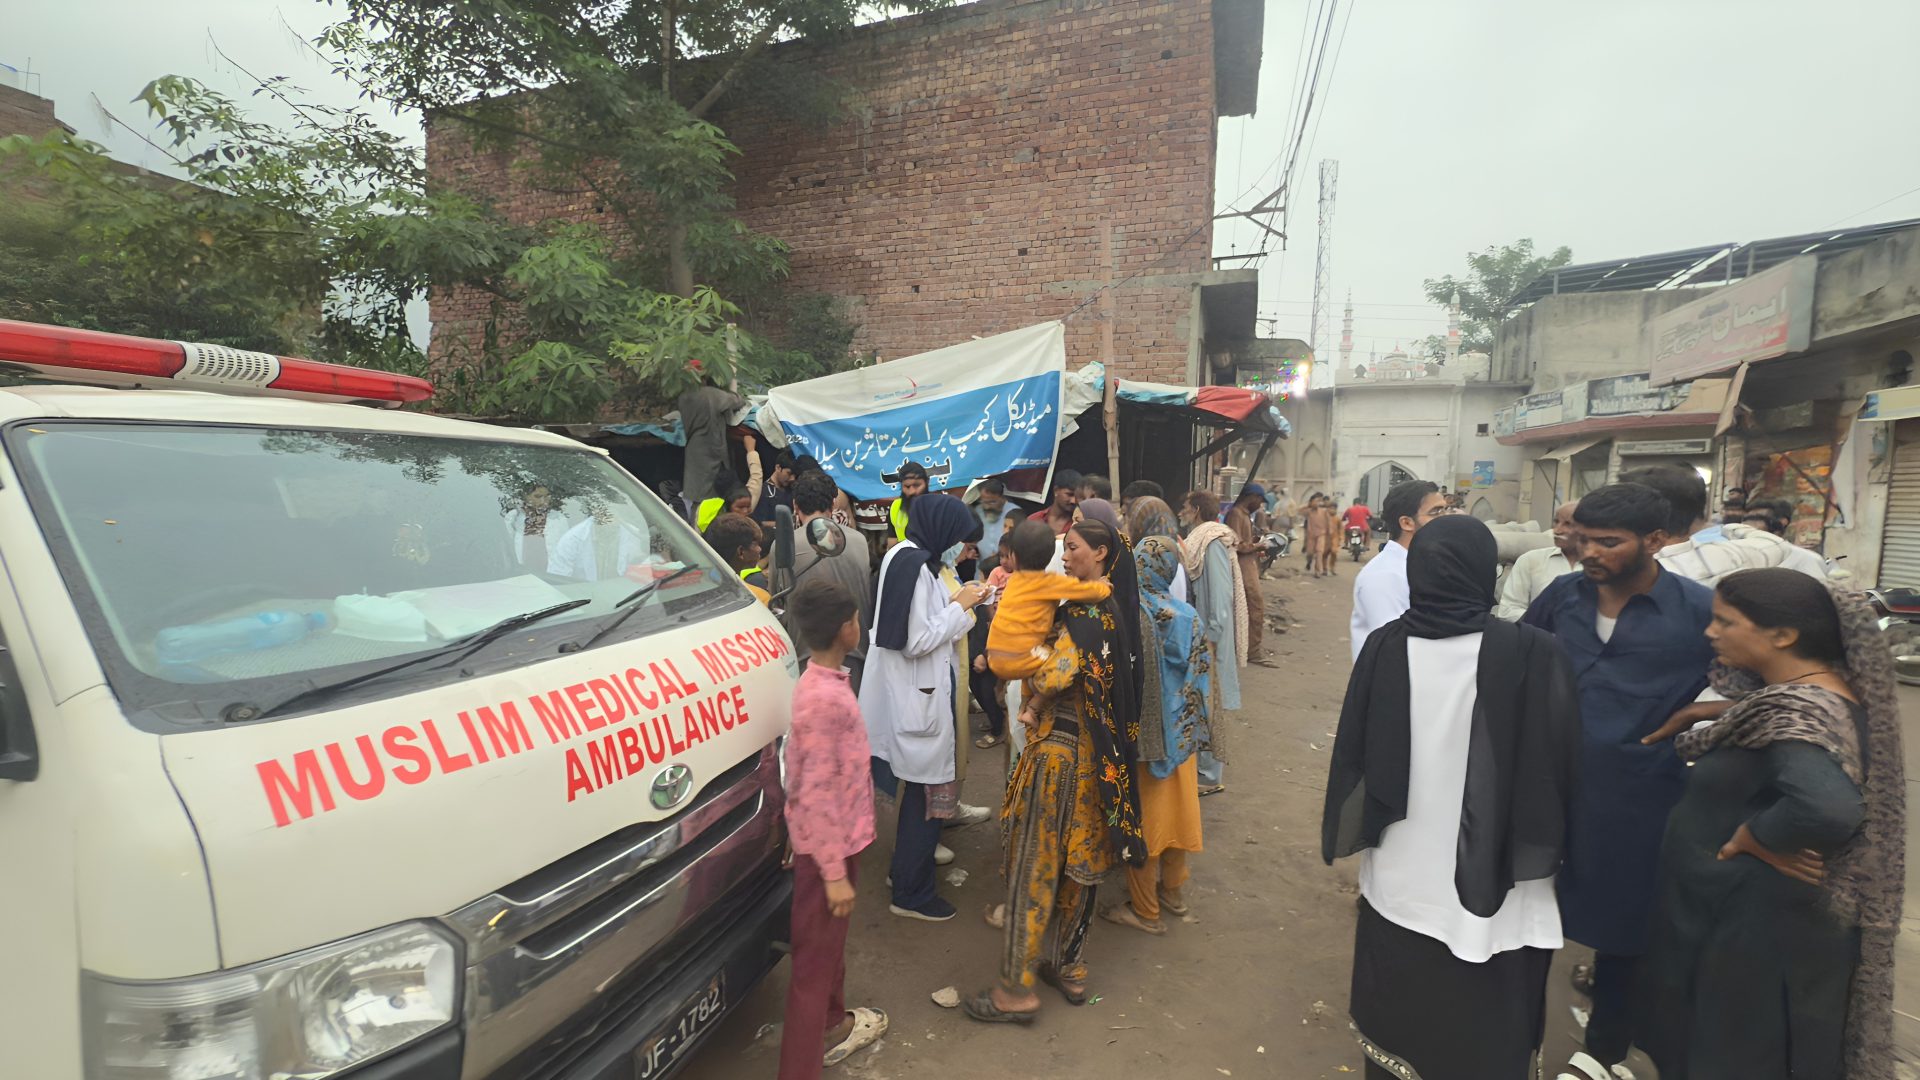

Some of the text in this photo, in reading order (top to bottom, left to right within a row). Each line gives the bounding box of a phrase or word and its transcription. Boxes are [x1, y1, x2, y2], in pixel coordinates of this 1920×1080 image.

[901, 420, 948, 453] برائے
[949, 393, 999, 459] کیمپ
[991, 382, 1052, 442] میڈیکل
[814, 441, 839, 471] سیلا
[840, 426, 898, 471] متاثرین
[255, 624, 789, 828] MUSLIM MEDICAL MISSION
[565, 685, 750, 803] AMBULANCE
